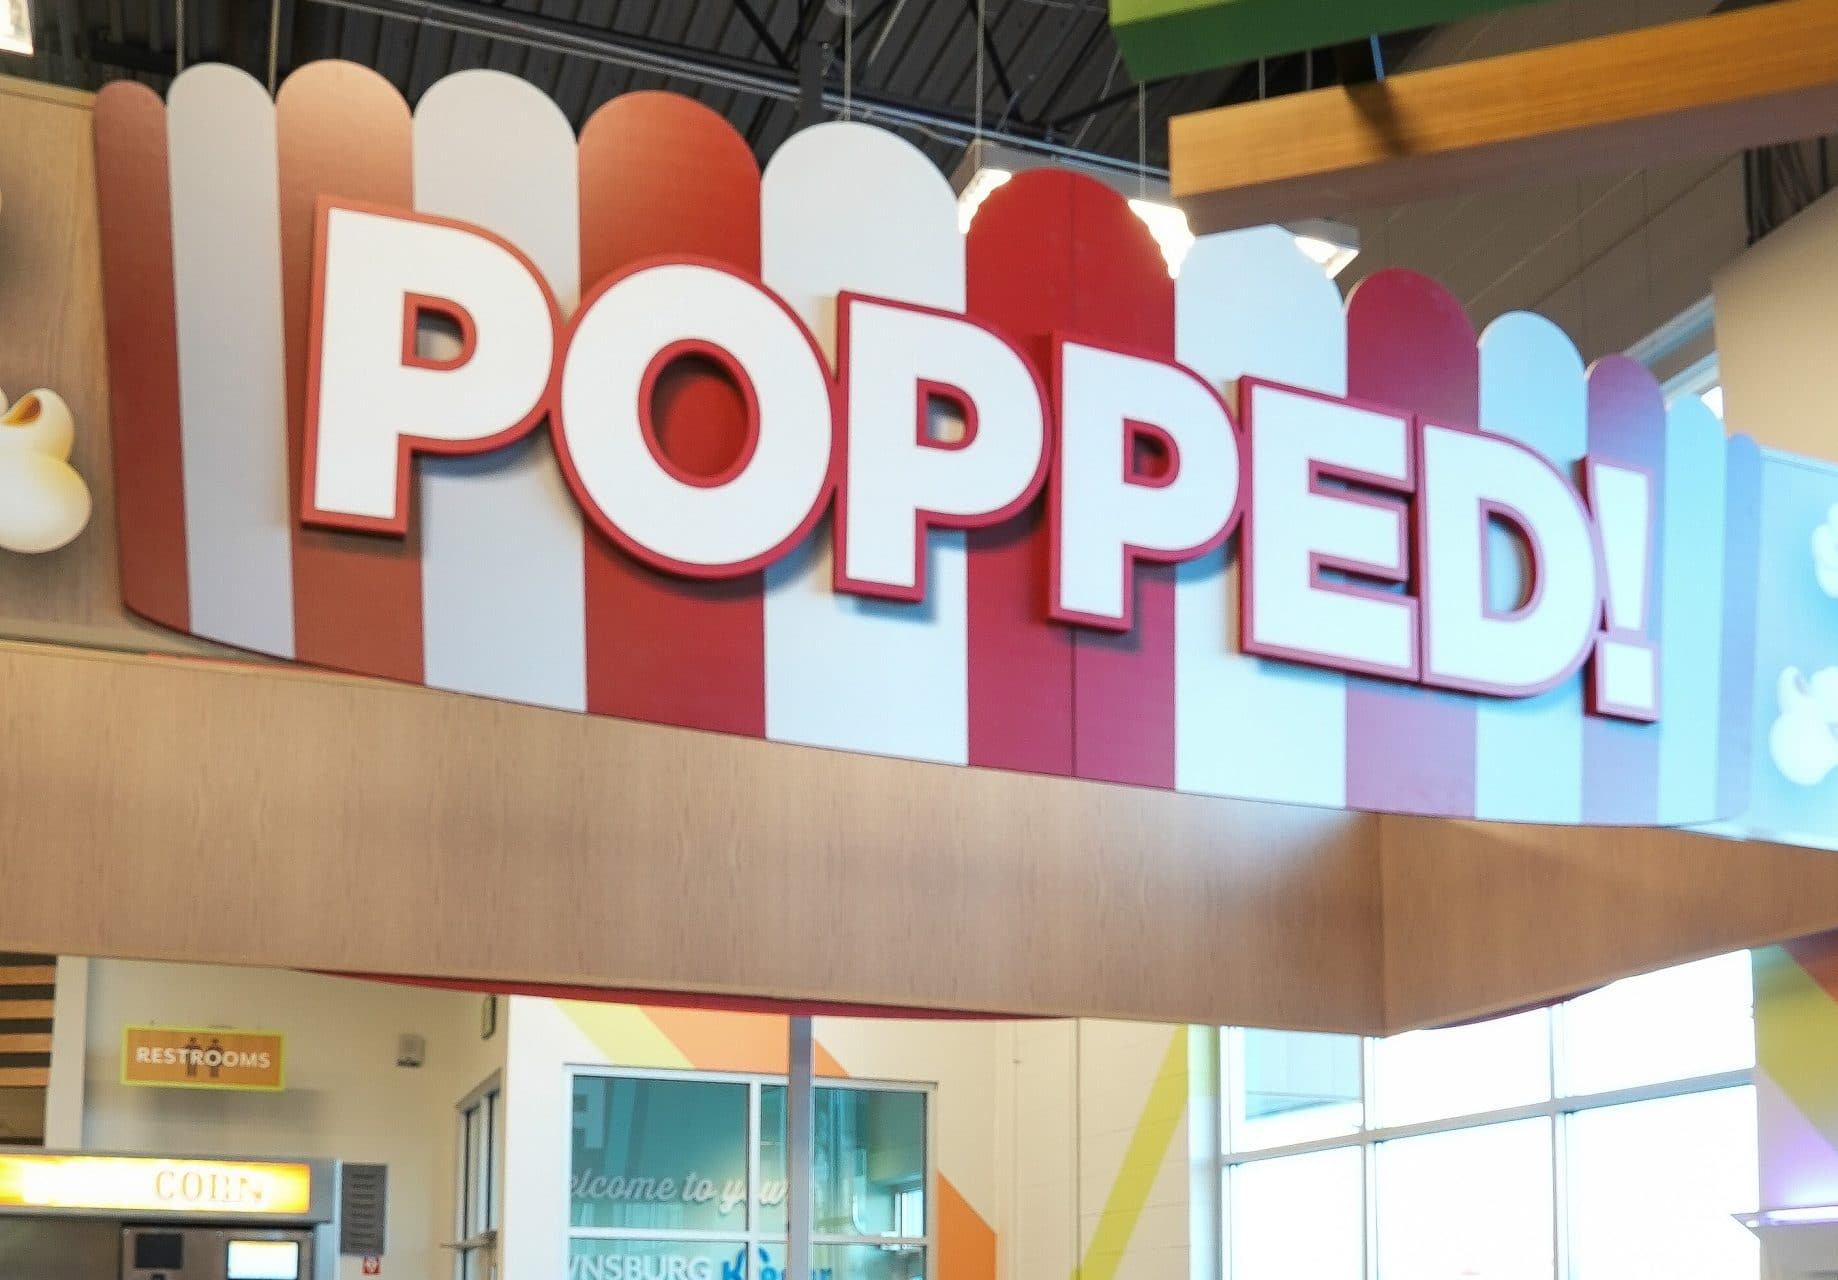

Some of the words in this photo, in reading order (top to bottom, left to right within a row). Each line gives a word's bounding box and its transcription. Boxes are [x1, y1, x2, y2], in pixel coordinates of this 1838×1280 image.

[304, 194, 1661, 722] POPPED!
[135, 1046, 271, 1069] RESTROOMS
[682, 1169, 714, 1202] to
